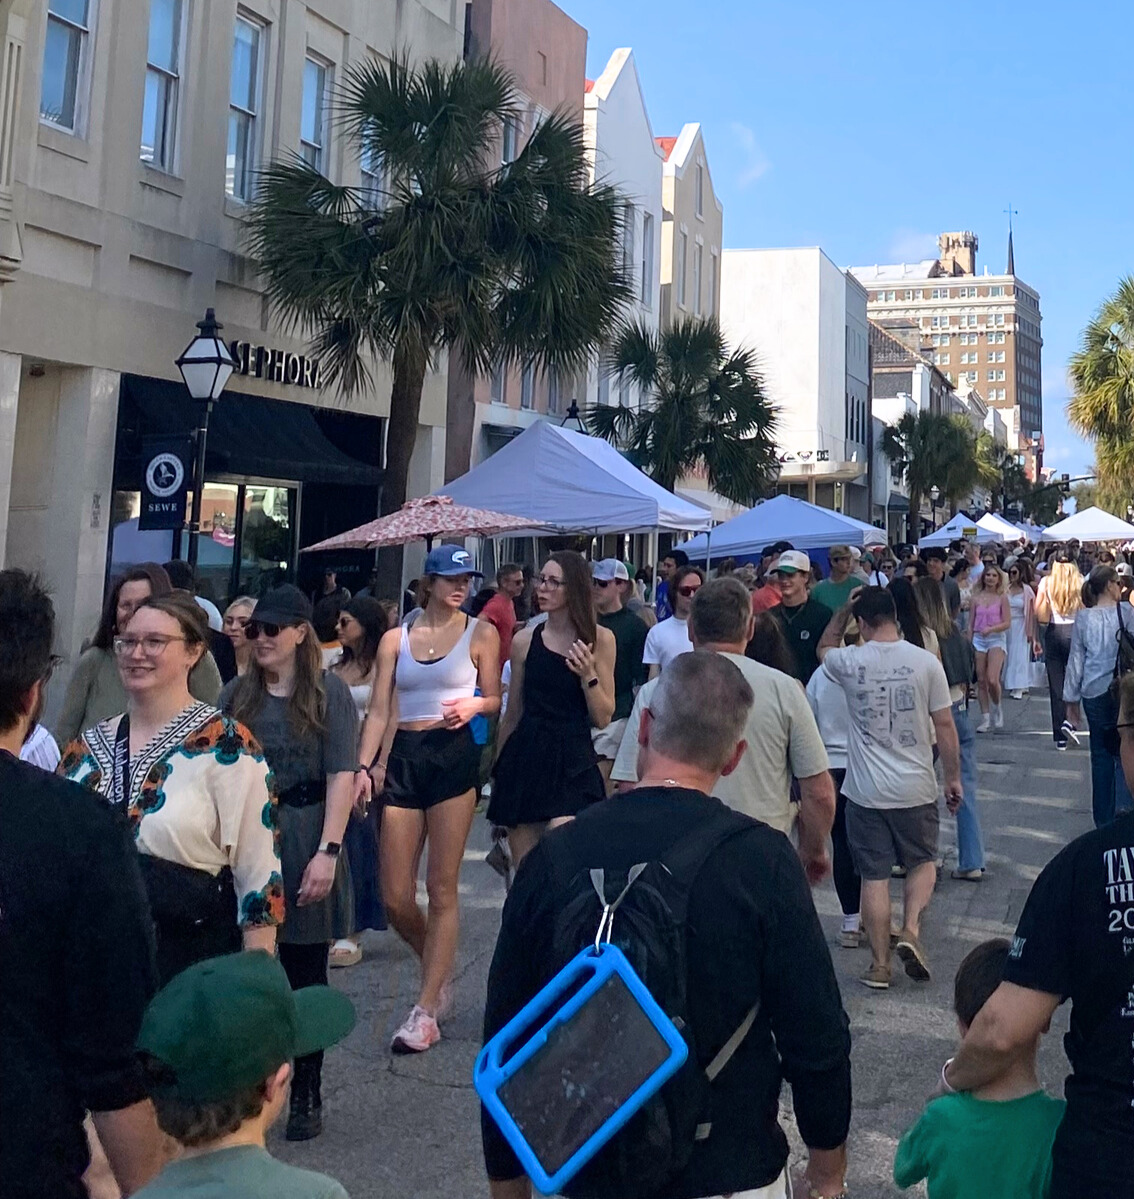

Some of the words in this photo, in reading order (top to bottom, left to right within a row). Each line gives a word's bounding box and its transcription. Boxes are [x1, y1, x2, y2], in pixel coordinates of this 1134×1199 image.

[230, 339, 324, 390] SEPHORA
[148, 502, 178, 512] SEWE
[114, 736, 129, 804] lululemon
